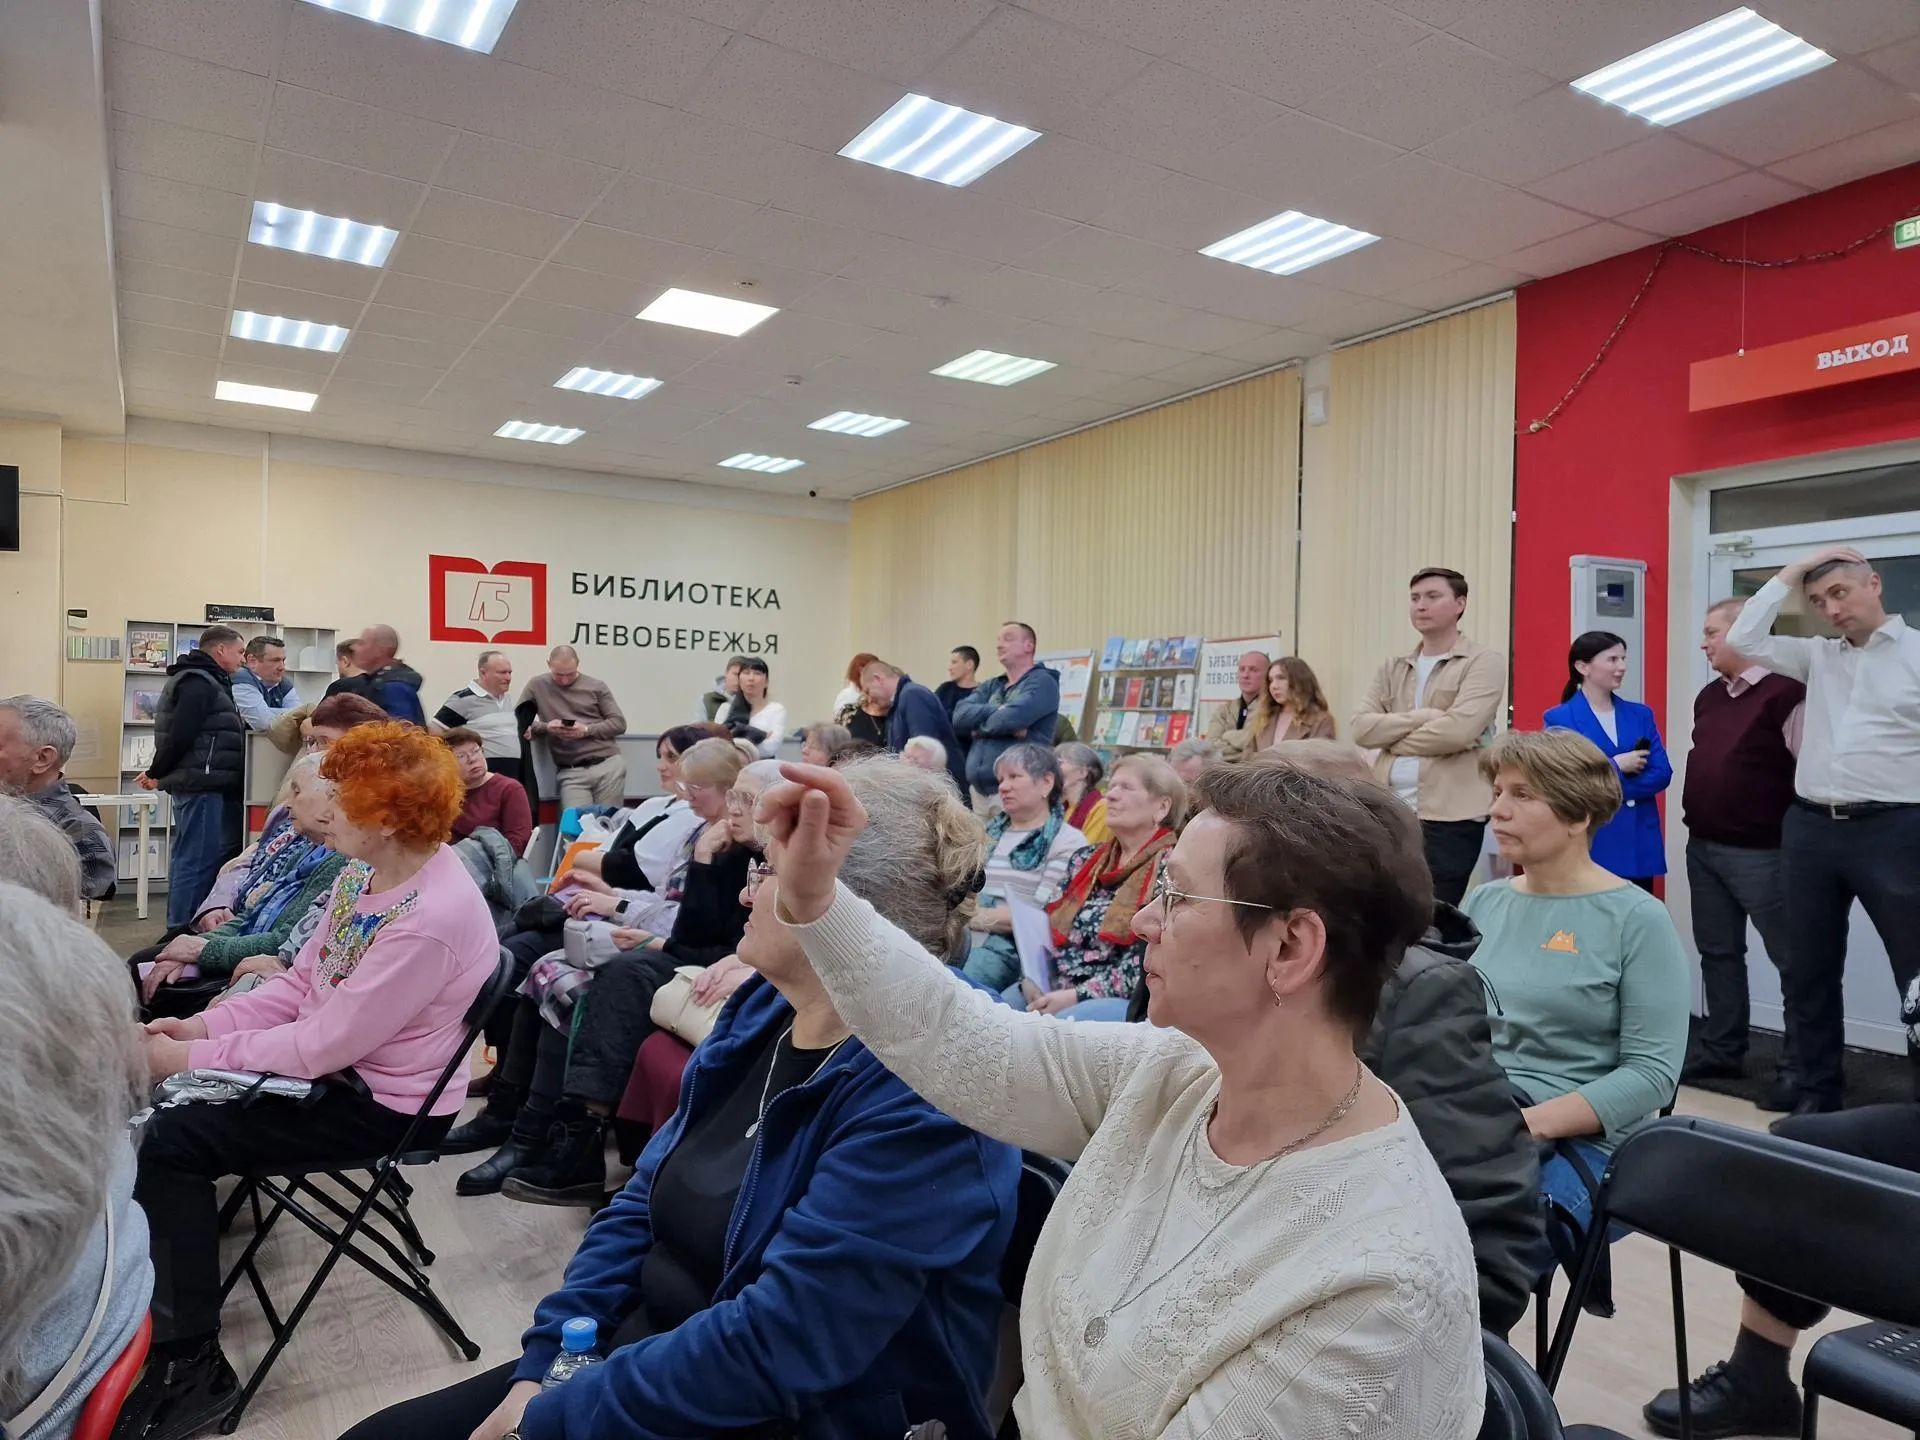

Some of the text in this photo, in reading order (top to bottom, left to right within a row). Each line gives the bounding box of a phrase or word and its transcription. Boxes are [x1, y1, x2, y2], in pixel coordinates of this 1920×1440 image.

[1816, 334, 1909, 370] ВЫХОД
[572, 571, 781, 610] БИБЛИОТЕКА
[569, 622, 779, 654] ЛЕВОБЕРЕЖЬЯ
